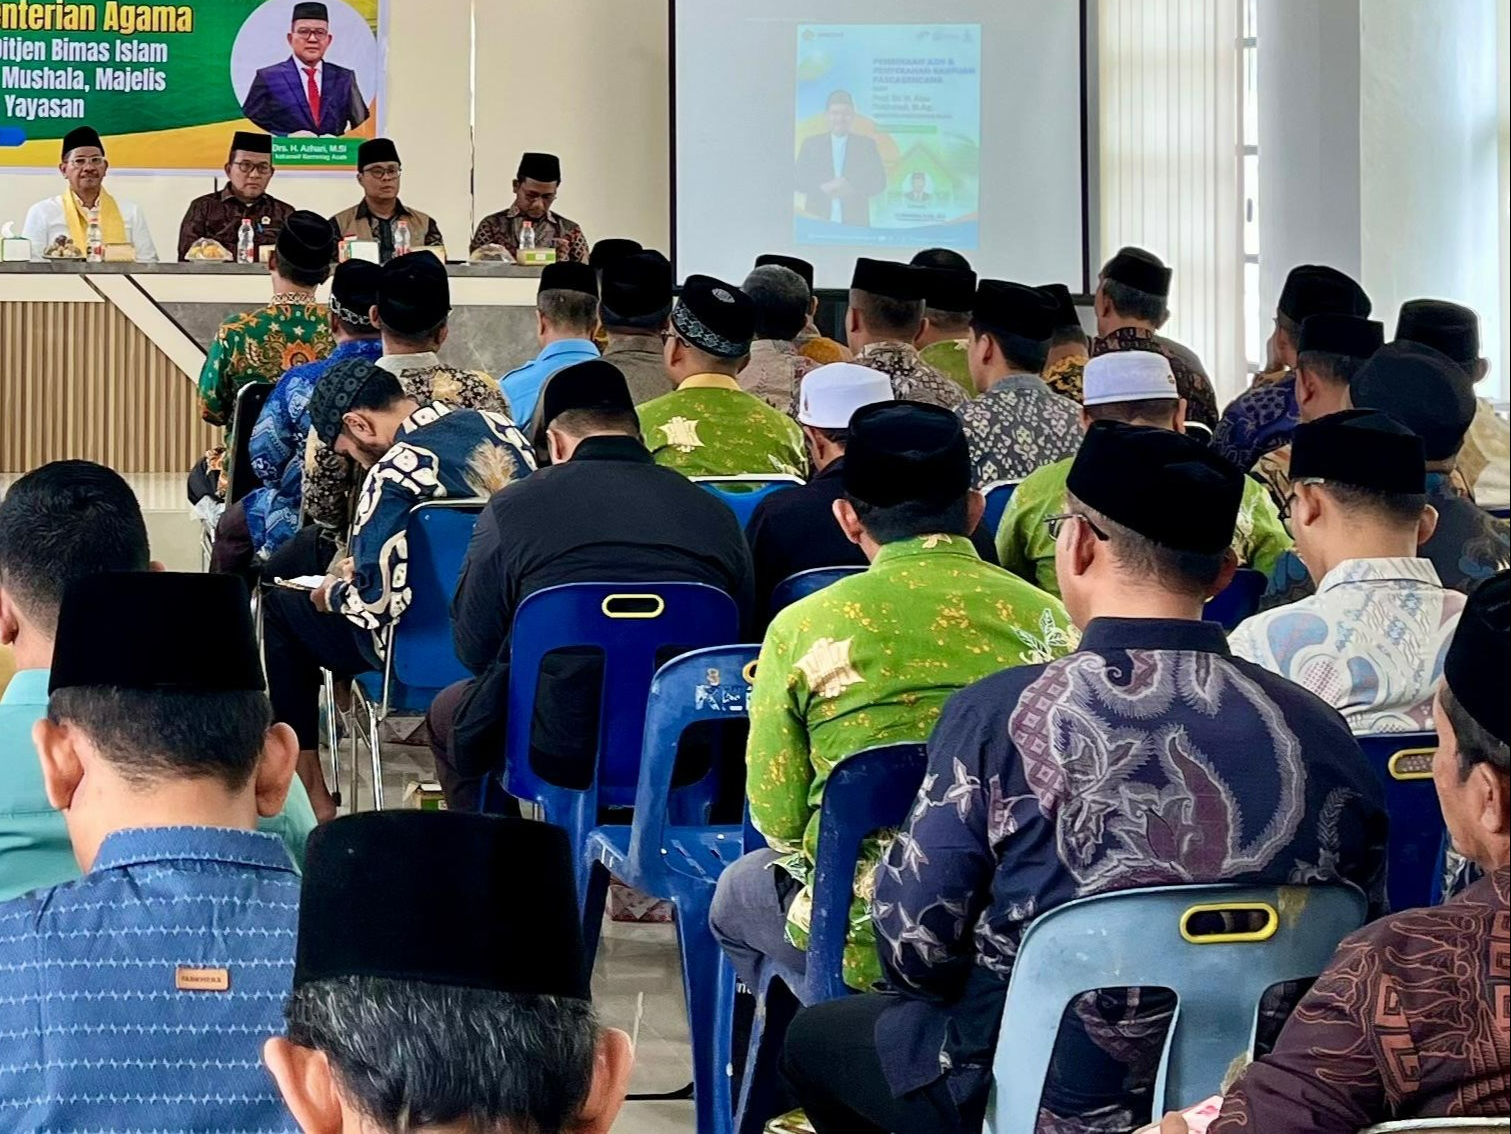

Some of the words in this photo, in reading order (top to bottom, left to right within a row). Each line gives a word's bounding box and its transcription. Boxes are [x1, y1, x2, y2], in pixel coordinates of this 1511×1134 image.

[103, 0, 193, 34] Agama
[51, 37, 110, 62] Bimas
[115, 39, 168, 63] Islam
[2, 66, 90, 93] Mushala,
[95, 67, 167, 93] Majelis
[4, 94, 85, 121] Yayasan
